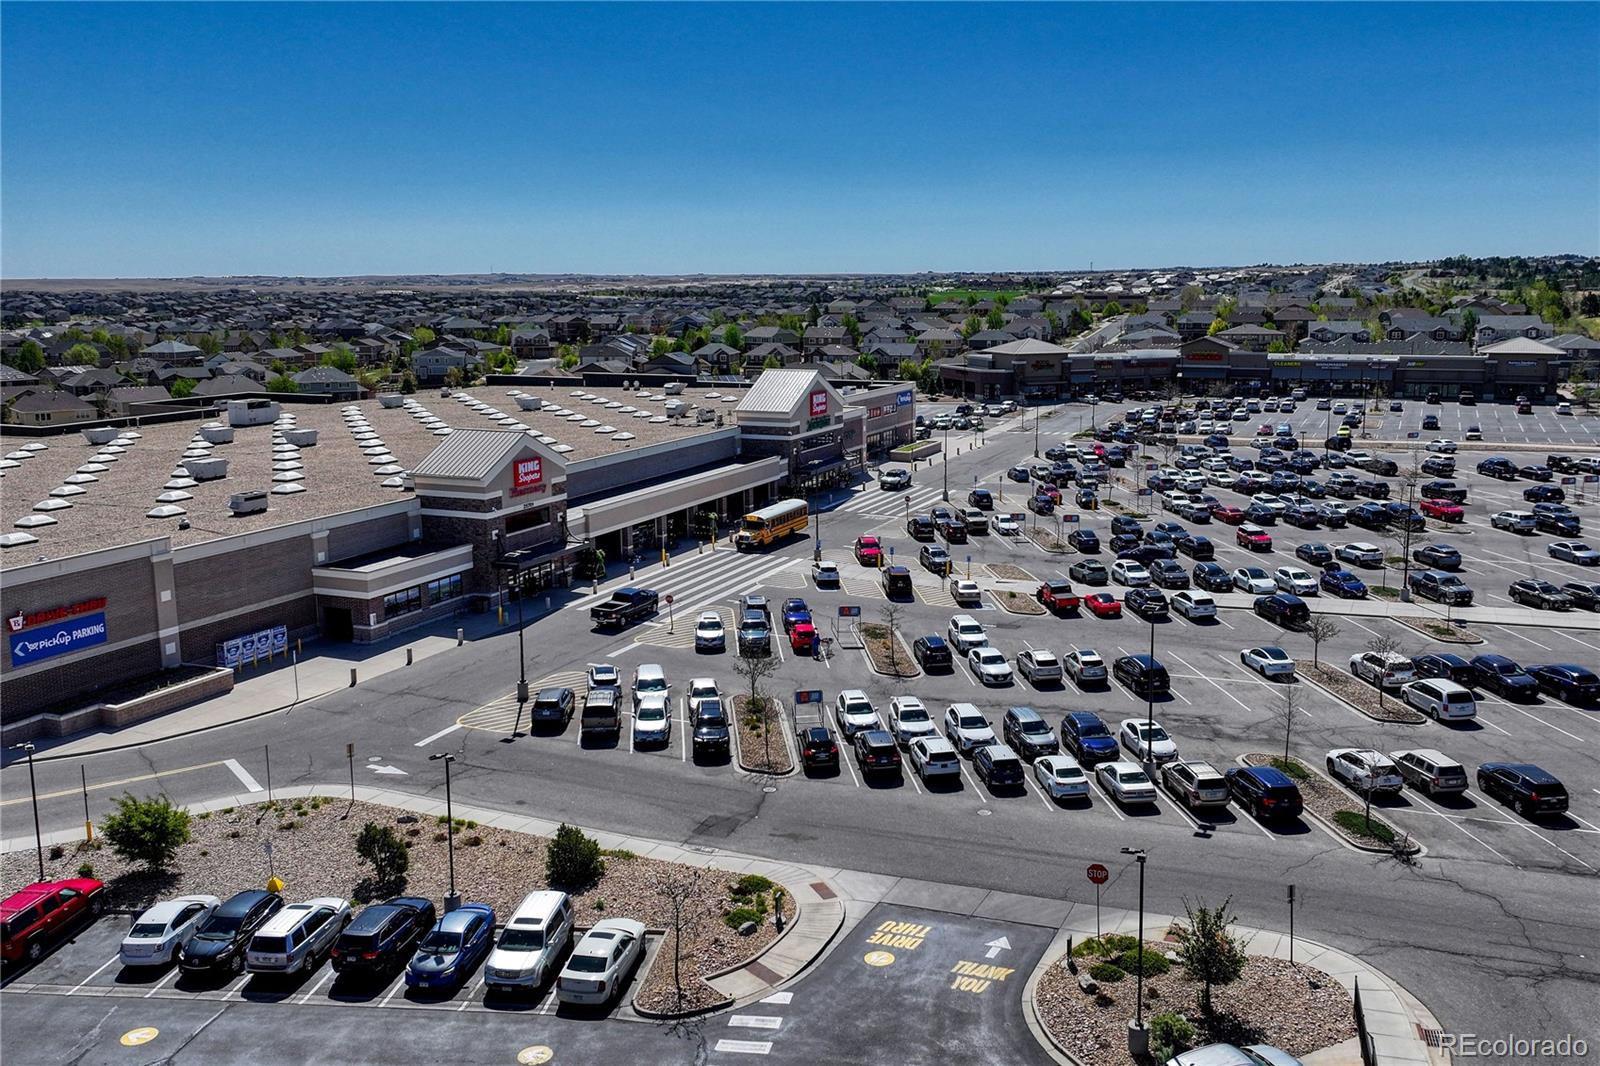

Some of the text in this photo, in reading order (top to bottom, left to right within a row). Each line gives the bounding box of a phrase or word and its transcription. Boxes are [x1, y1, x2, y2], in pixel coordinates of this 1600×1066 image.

[519, 460, 540, 473] KING
[72, 623, 105, 640] PARKING
[1088, 869, 1107, 879] STOP
[875, 920, 932, 938] THRU
[865, 931, 924, 950] DRIVE
[950, 960, 1015, 982] THANK
[951, 975, 991, 994] YOU
